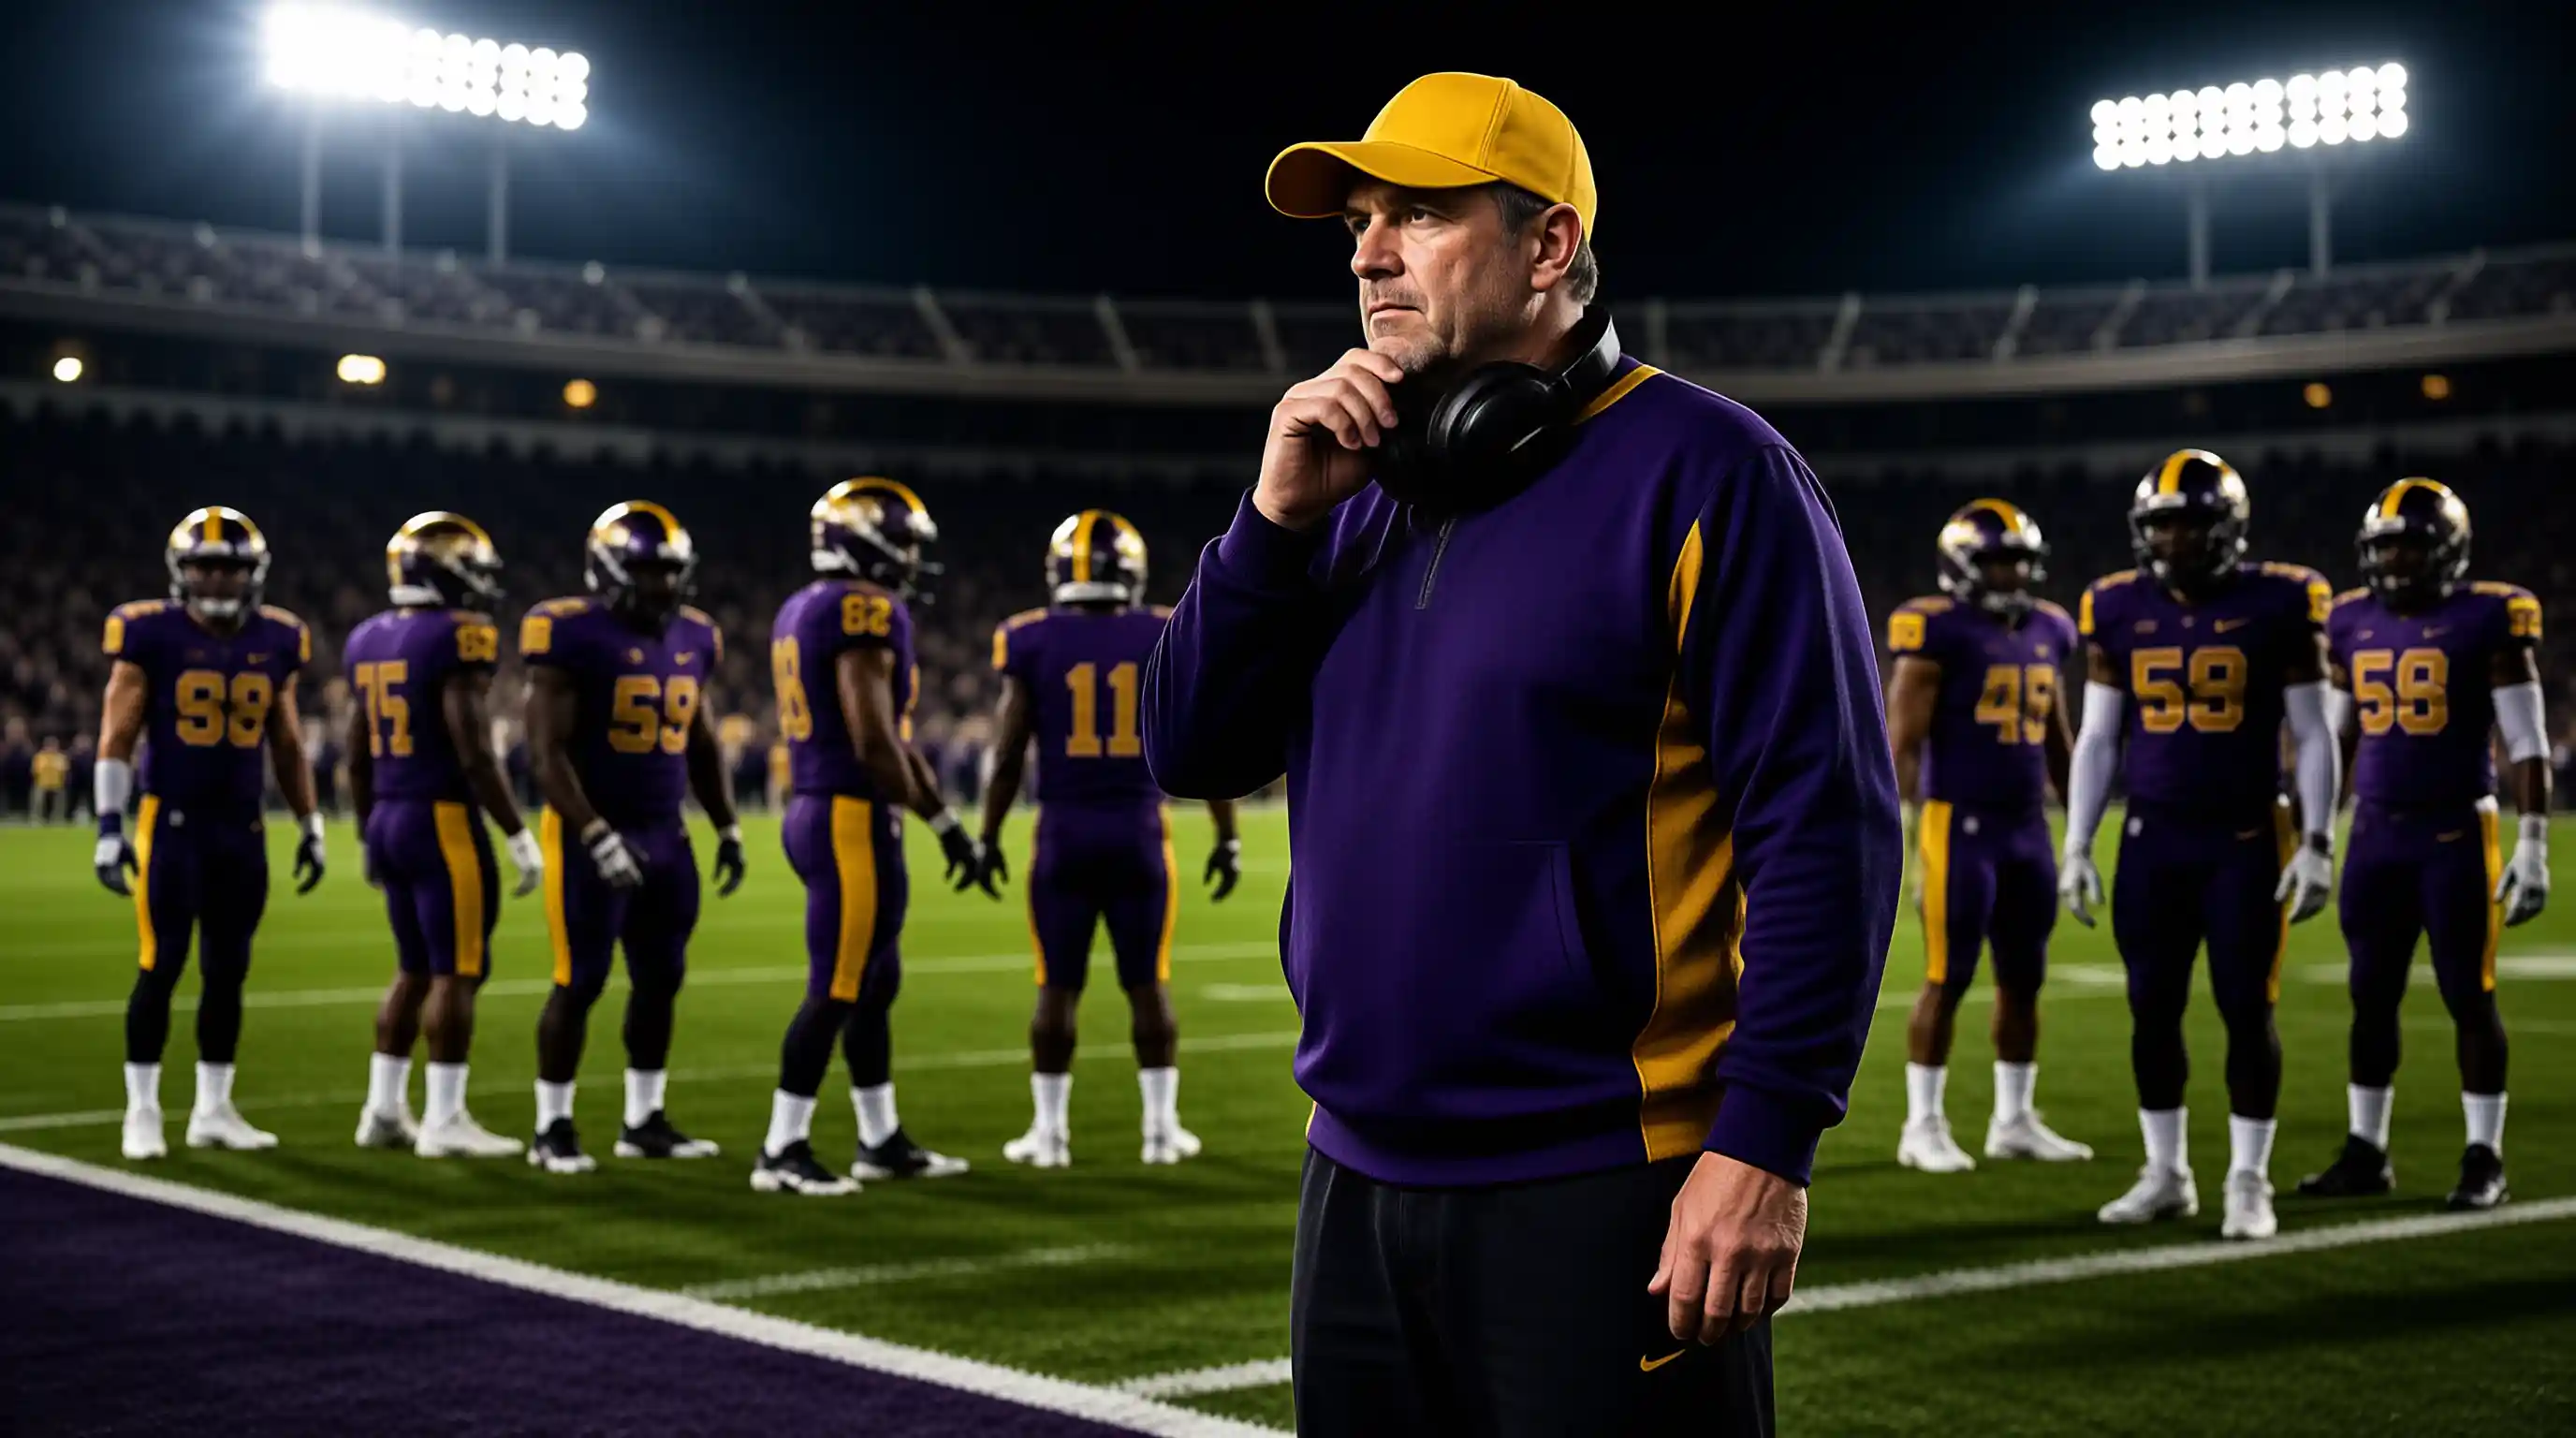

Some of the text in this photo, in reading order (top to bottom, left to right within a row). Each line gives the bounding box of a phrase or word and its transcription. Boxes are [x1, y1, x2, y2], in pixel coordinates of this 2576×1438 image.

[842, 593, 892, 637] 82
[355, 658, 413, 759] 75
[607, 674, 699, 755] 59
[1065, 662, 1140, 757] 11
[2130, 645, 2247, 733] 59
